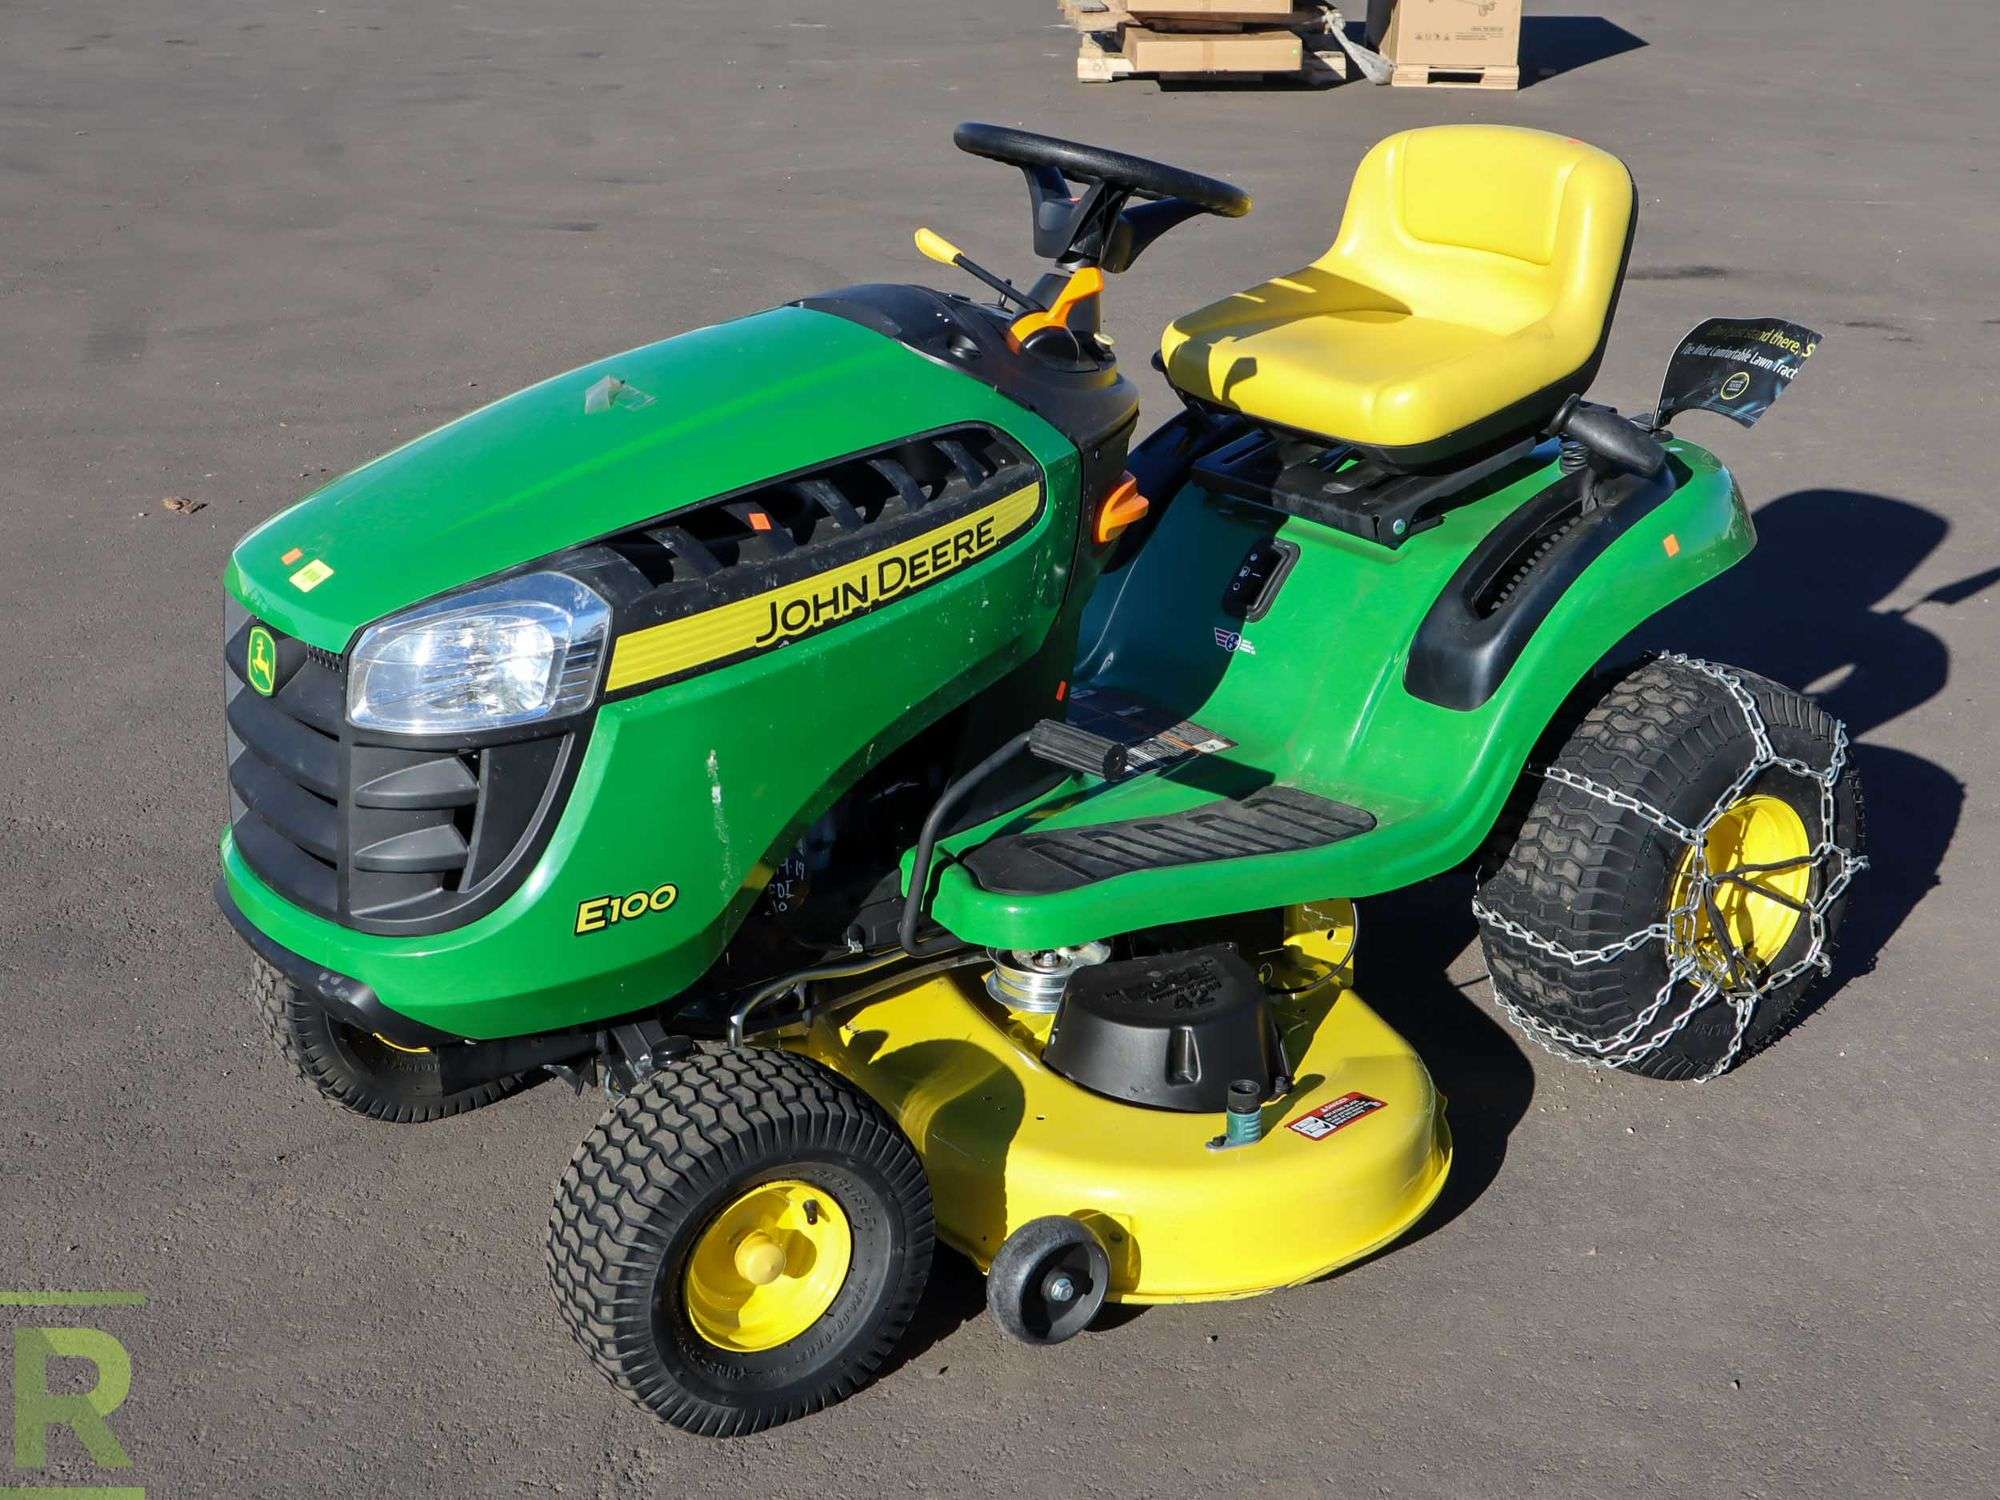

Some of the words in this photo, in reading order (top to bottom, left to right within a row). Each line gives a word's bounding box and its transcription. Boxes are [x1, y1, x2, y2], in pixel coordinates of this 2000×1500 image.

[1750, 351, 1773, 370] Lawn
[1772, 358, 1798, 379] Tract
[756, 574, 868, 644] JOHN
[877, 515, 996, 597] DEERE
[574, 883, 679, 936] E100
